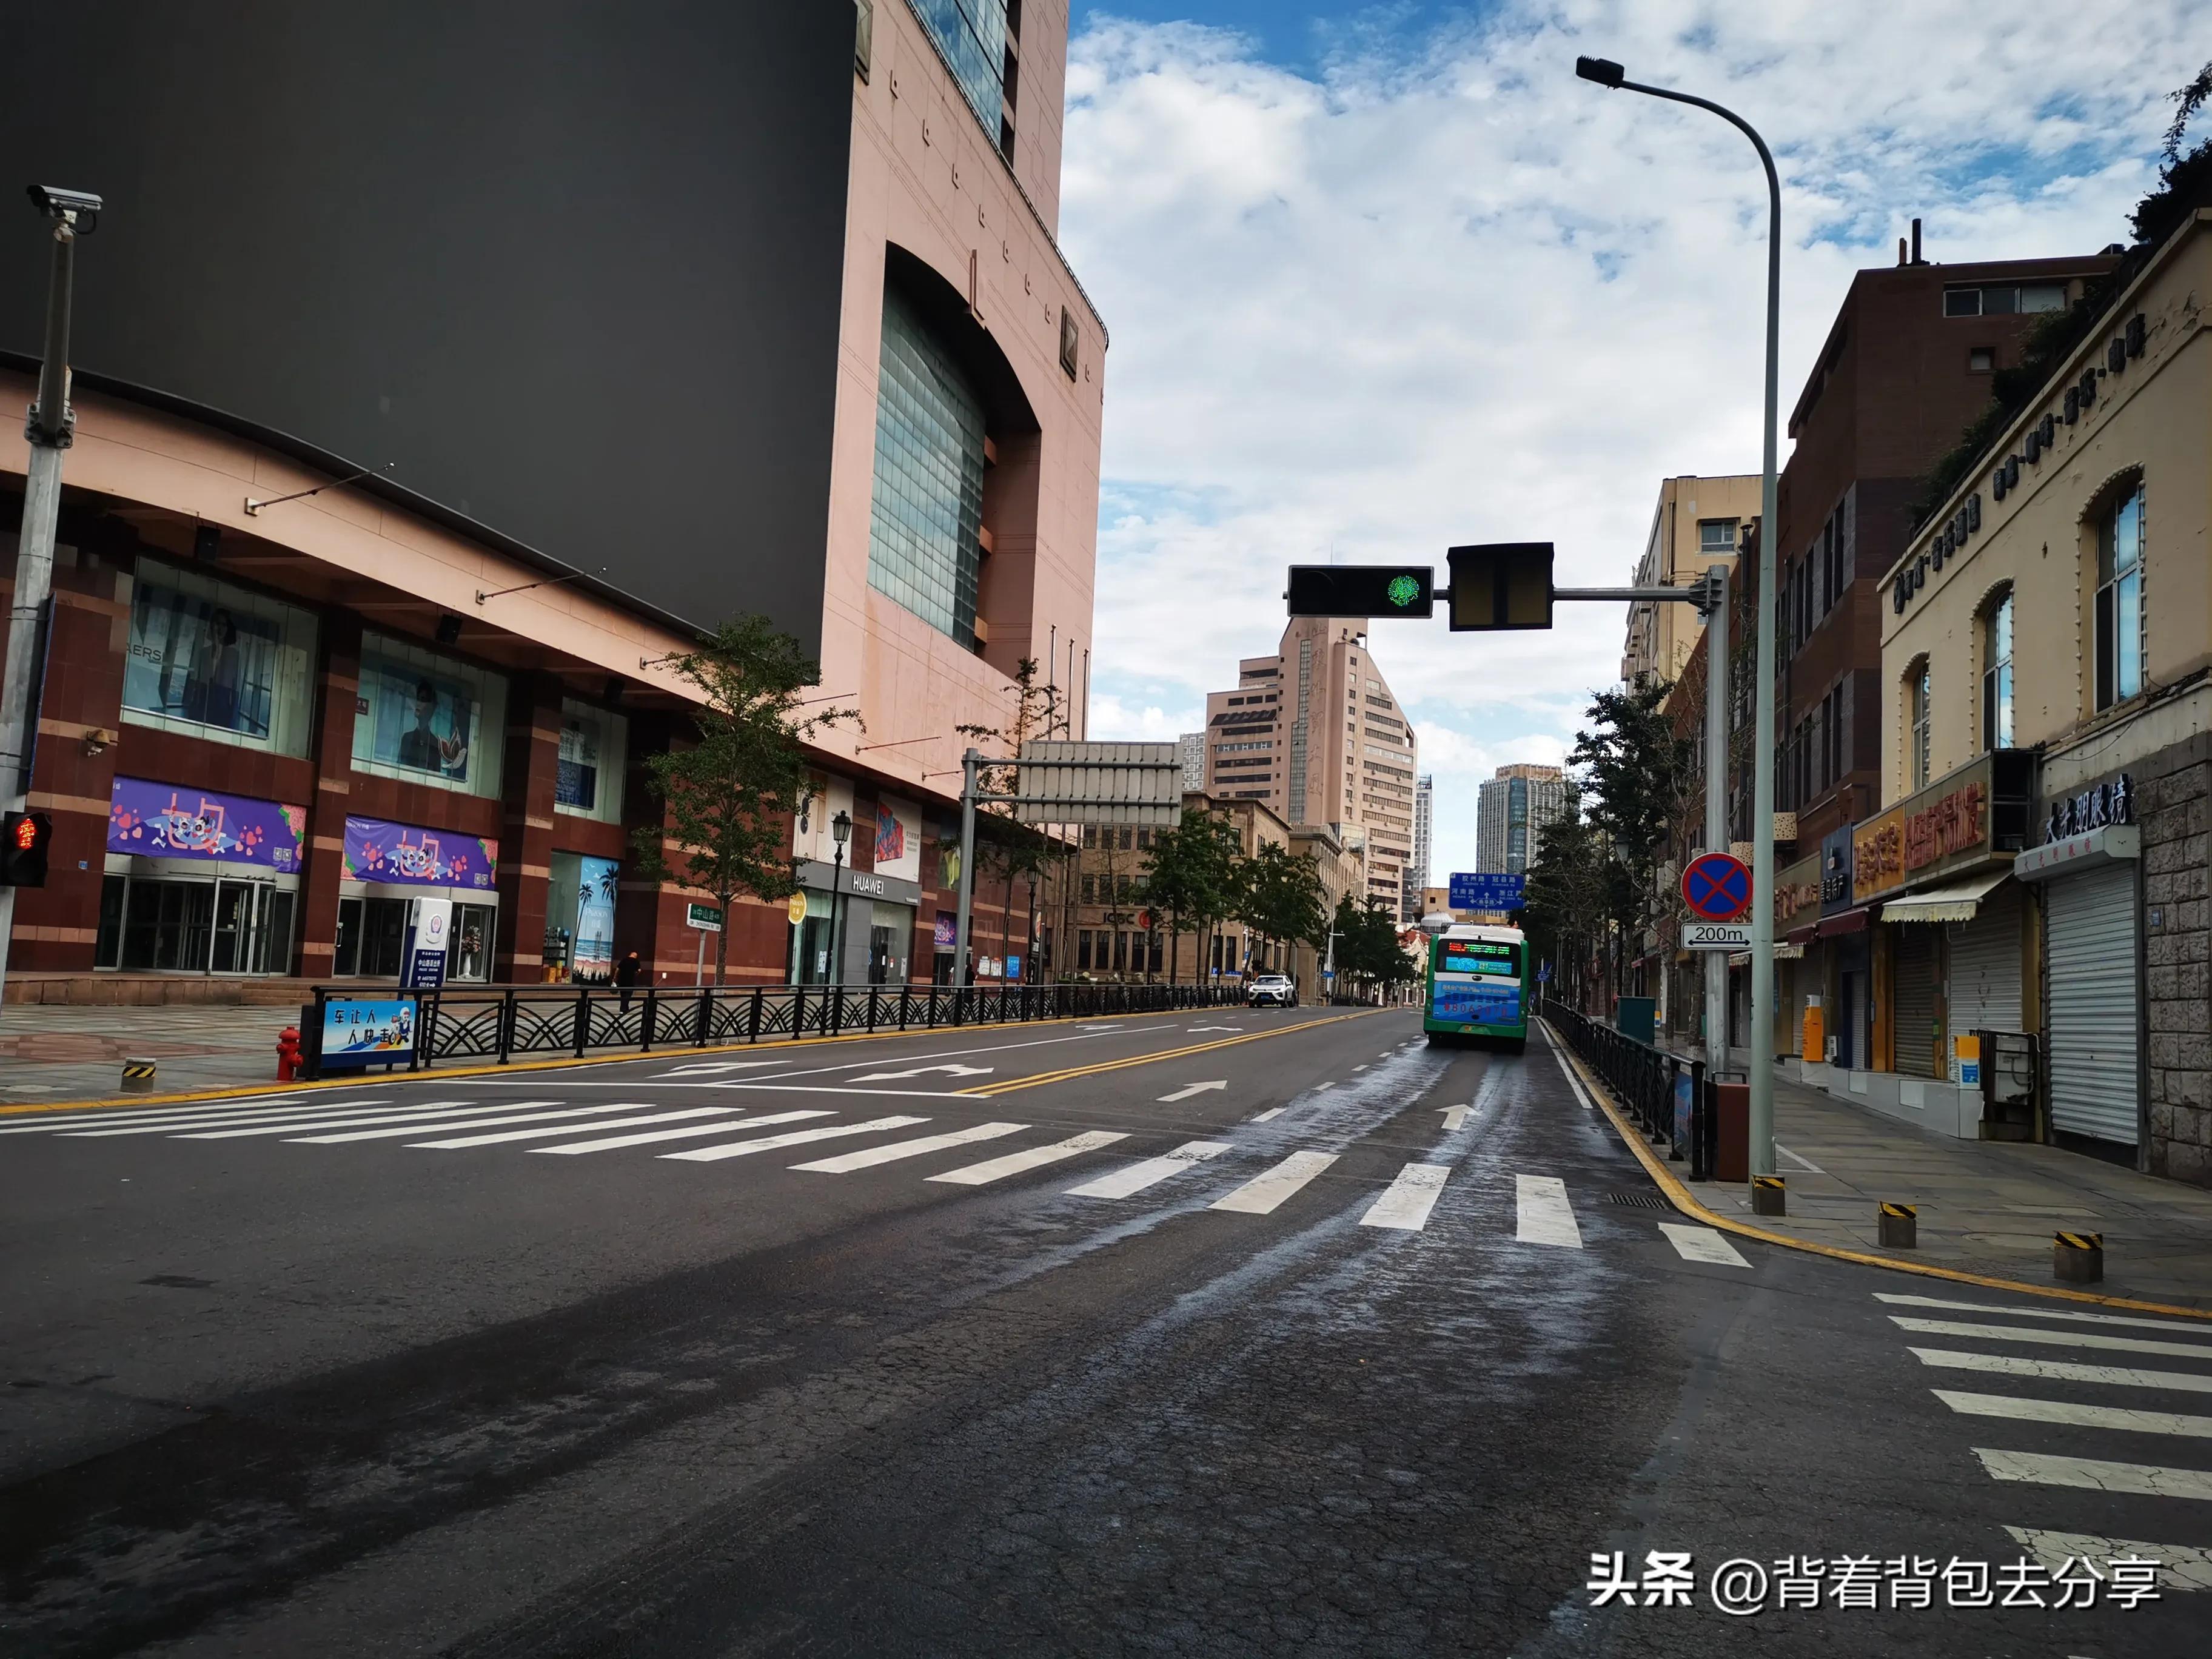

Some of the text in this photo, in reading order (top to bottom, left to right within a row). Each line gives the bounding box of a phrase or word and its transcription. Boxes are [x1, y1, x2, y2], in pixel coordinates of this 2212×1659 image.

[853, 875, 884, 896] HUAWEI
[697, 907, 714, 921] 中山路
[1695, 927, 1743, 940] 200m
[334, 1008, 376, 1024] 车让人
[348, 1028, 390, 1045] 人快走
